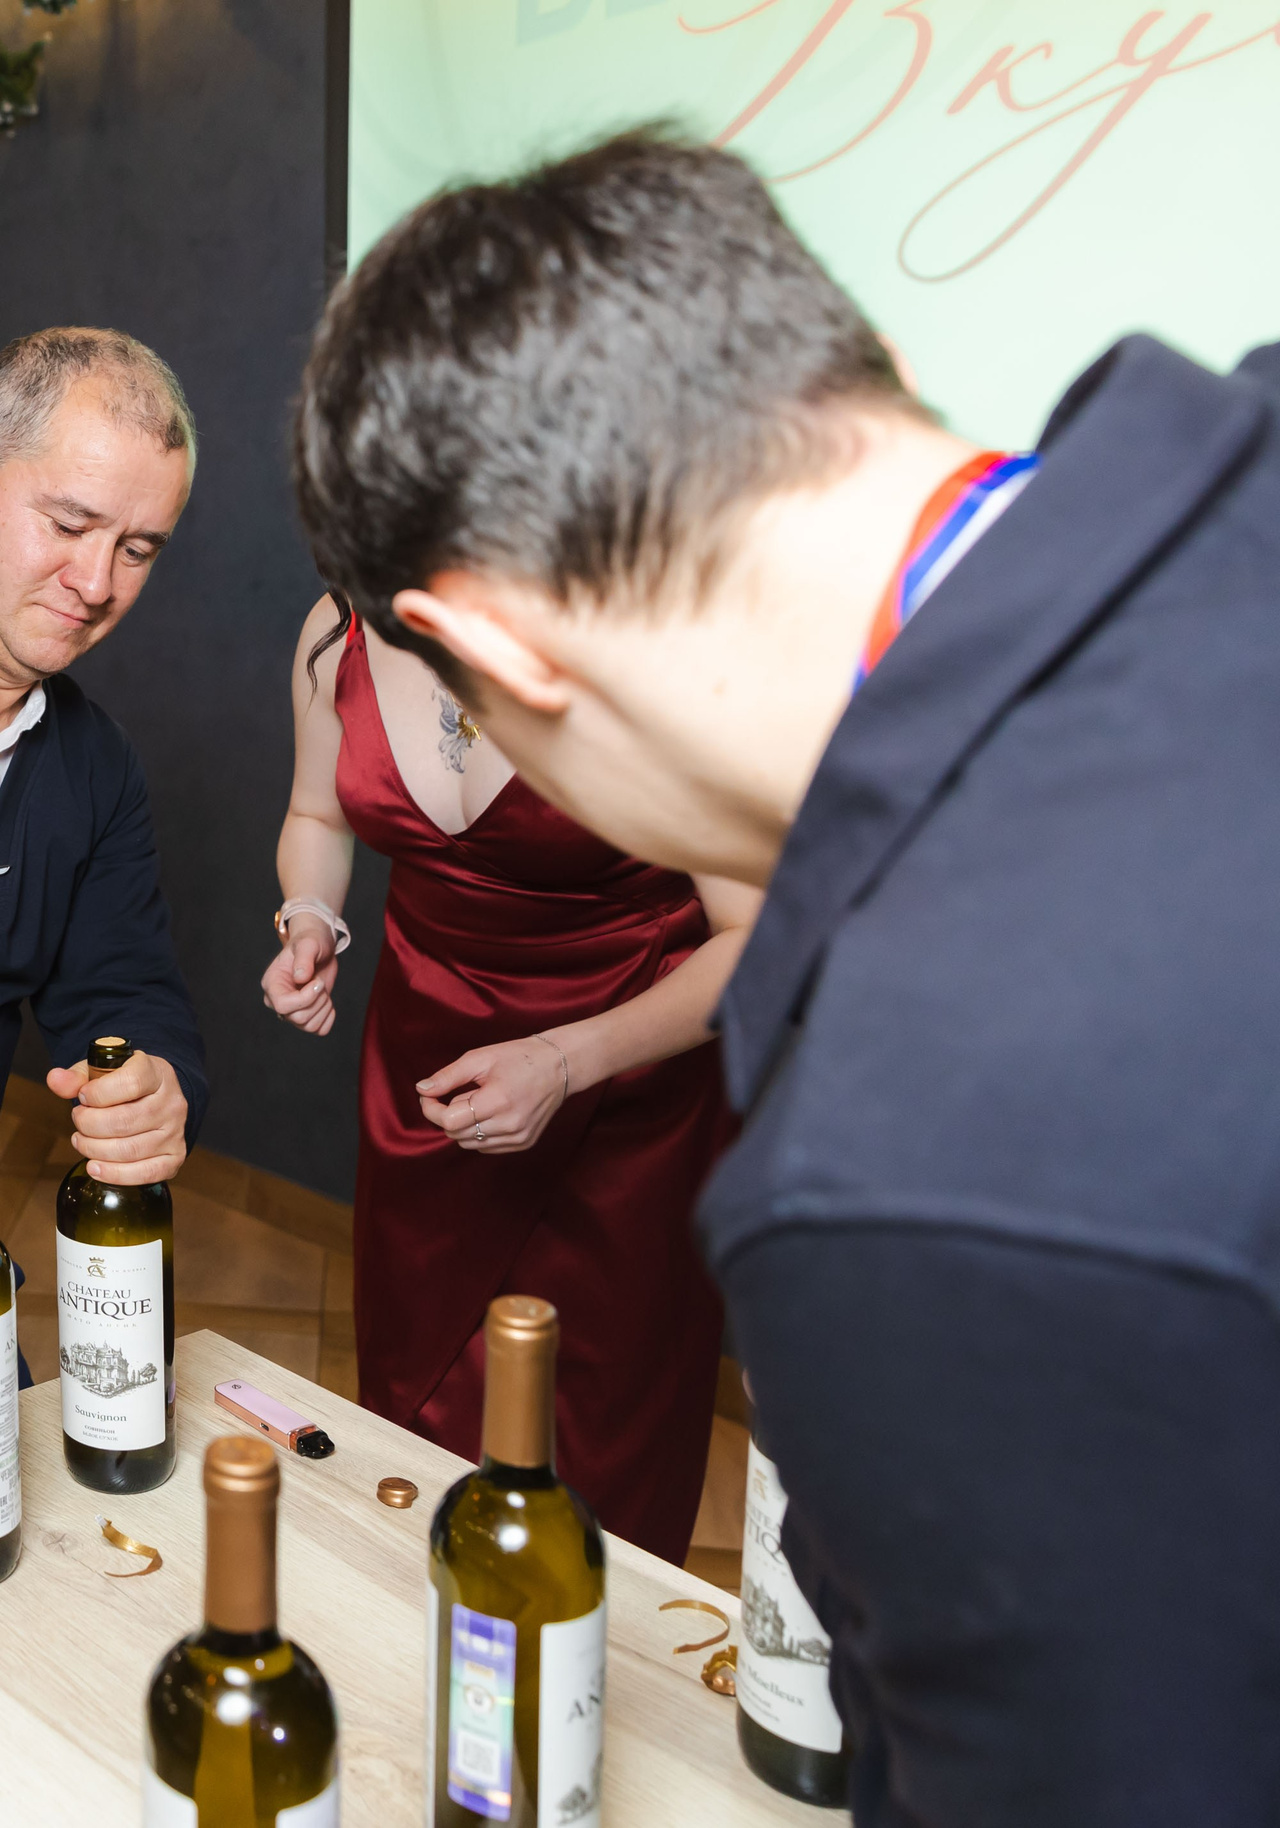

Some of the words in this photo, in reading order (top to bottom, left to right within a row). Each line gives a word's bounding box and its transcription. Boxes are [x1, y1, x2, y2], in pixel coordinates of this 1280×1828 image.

[677, 0, 1280, 282] Вку
[68, 1281, 131, 1299] CHATEAU
[59, 1286, 153, 1321] ANTIQUE
[75, 1404, 127, 1422] Sauvignon
